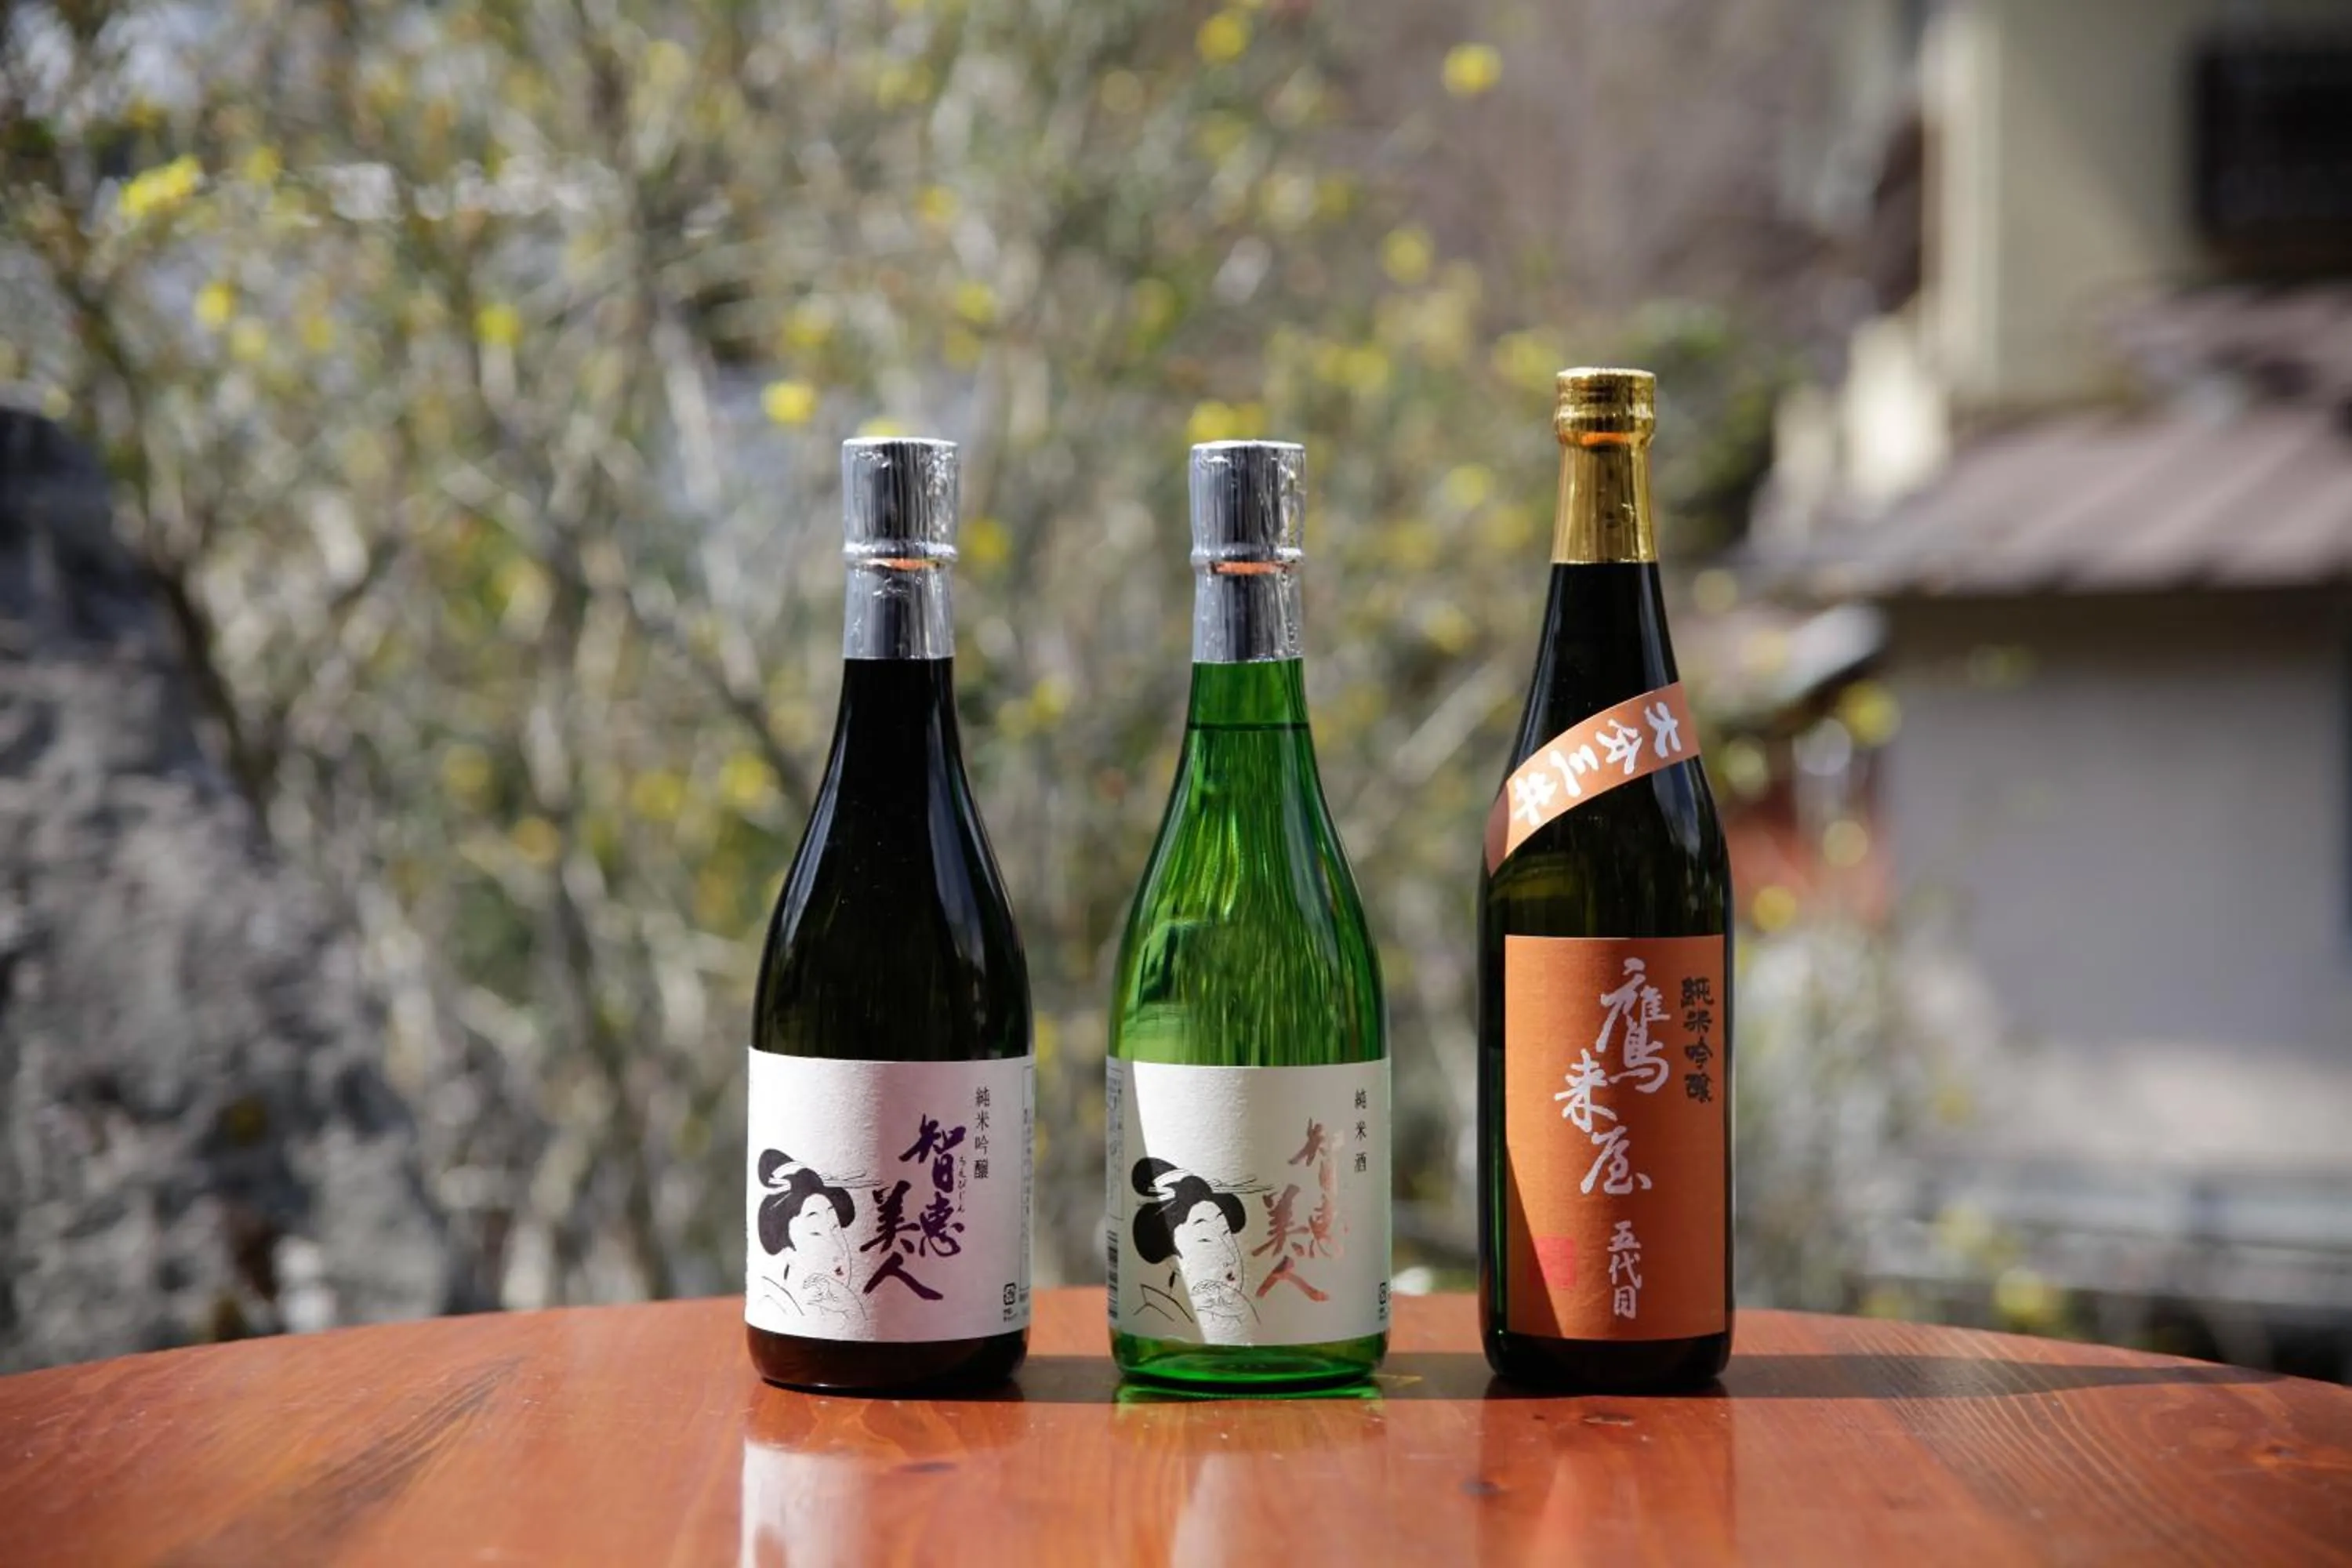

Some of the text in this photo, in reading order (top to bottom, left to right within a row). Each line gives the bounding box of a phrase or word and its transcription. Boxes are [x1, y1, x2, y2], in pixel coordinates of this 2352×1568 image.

[1555, 957, 1671, 1196] 鷹来屋
[1680, 976, 1715, 1104] 純米吟醸
[974, 1086, 990, 1180] 純米吟醸
[1353, 1087, 1369, 1174] 純米酒
[1606, 1220, 1643, 1320] 五代目
